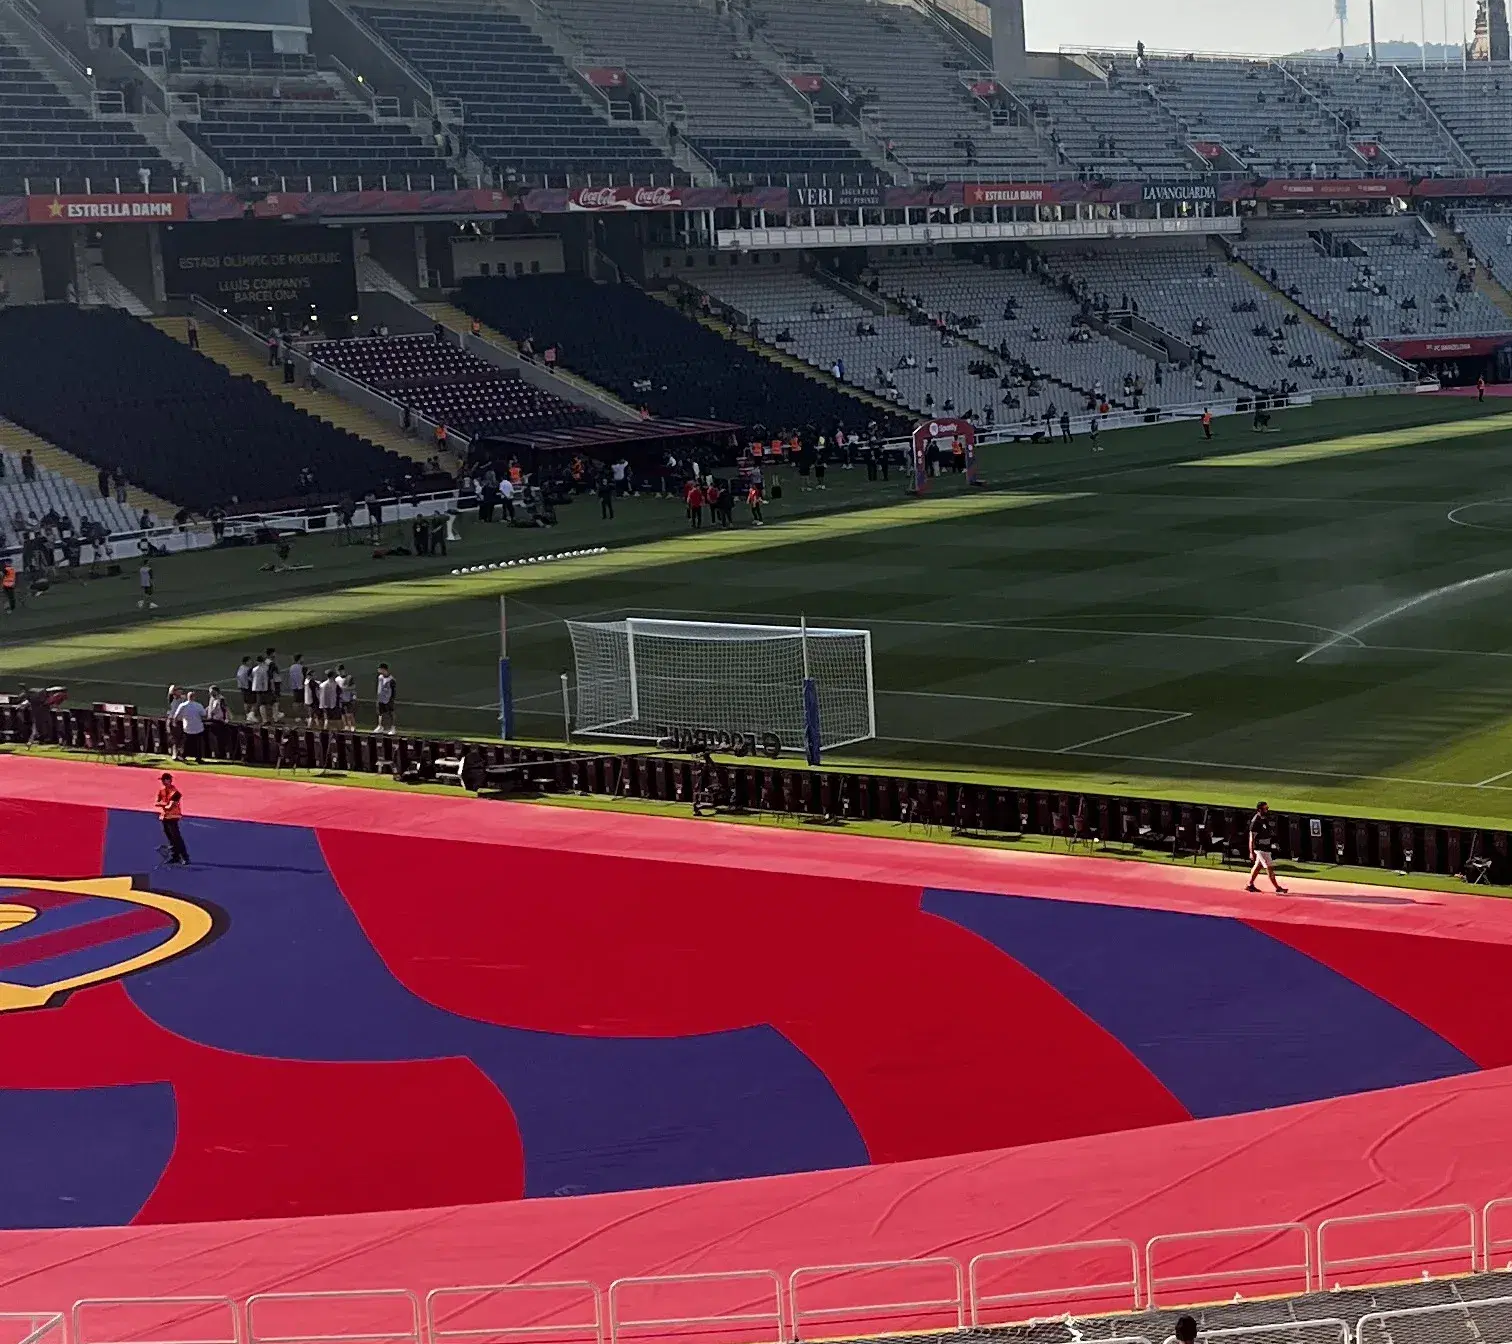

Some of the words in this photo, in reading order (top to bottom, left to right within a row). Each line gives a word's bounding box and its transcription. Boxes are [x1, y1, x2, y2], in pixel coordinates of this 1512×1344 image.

[797, 187, 833, 205] VERI
[985, 190, 1019, 201] ESTRELLA
[1020, 190, 1042, 200] DAMM
[67, 203, 130, 217] ESTRELLA
[132, 203, 172, 216] DAMM
[234, 289, 298, 303] BARCELONA
